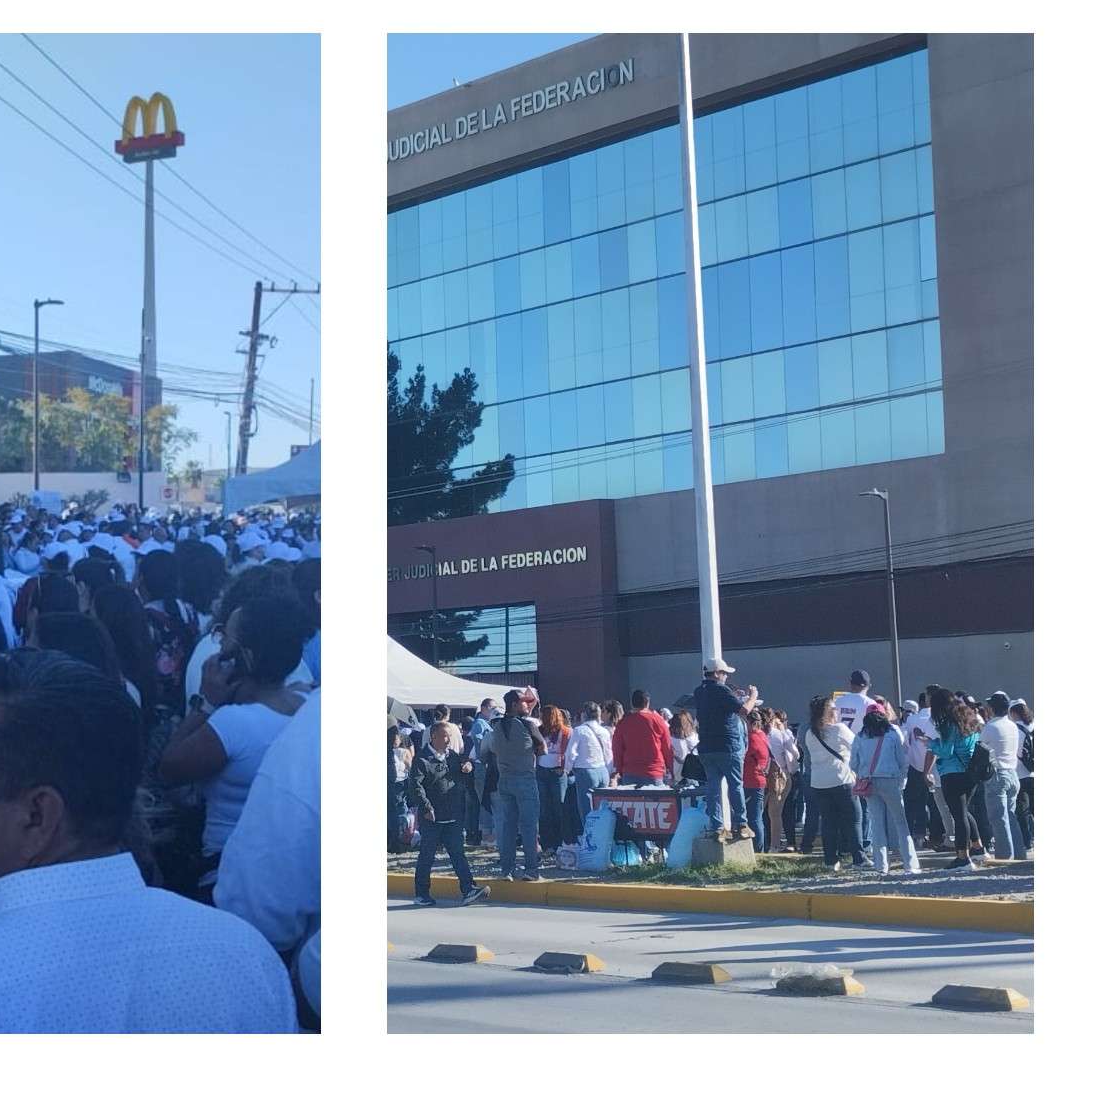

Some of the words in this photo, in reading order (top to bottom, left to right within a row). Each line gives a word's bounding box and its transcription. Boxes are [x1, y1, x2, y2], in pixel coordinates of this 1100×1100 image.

[387, 124, 453, 163] UDICIAL
[456, 111, 479, 140] DE
[482, 103, 507, 130] LA
[510, 58, 635, 121] FEDERACION
[461, 558, 478, 574] DE
[481, 556, 498, 572] LA
[501, 546, 587, 570] FEDERACION
[608, 800, 673, 830] CATE
